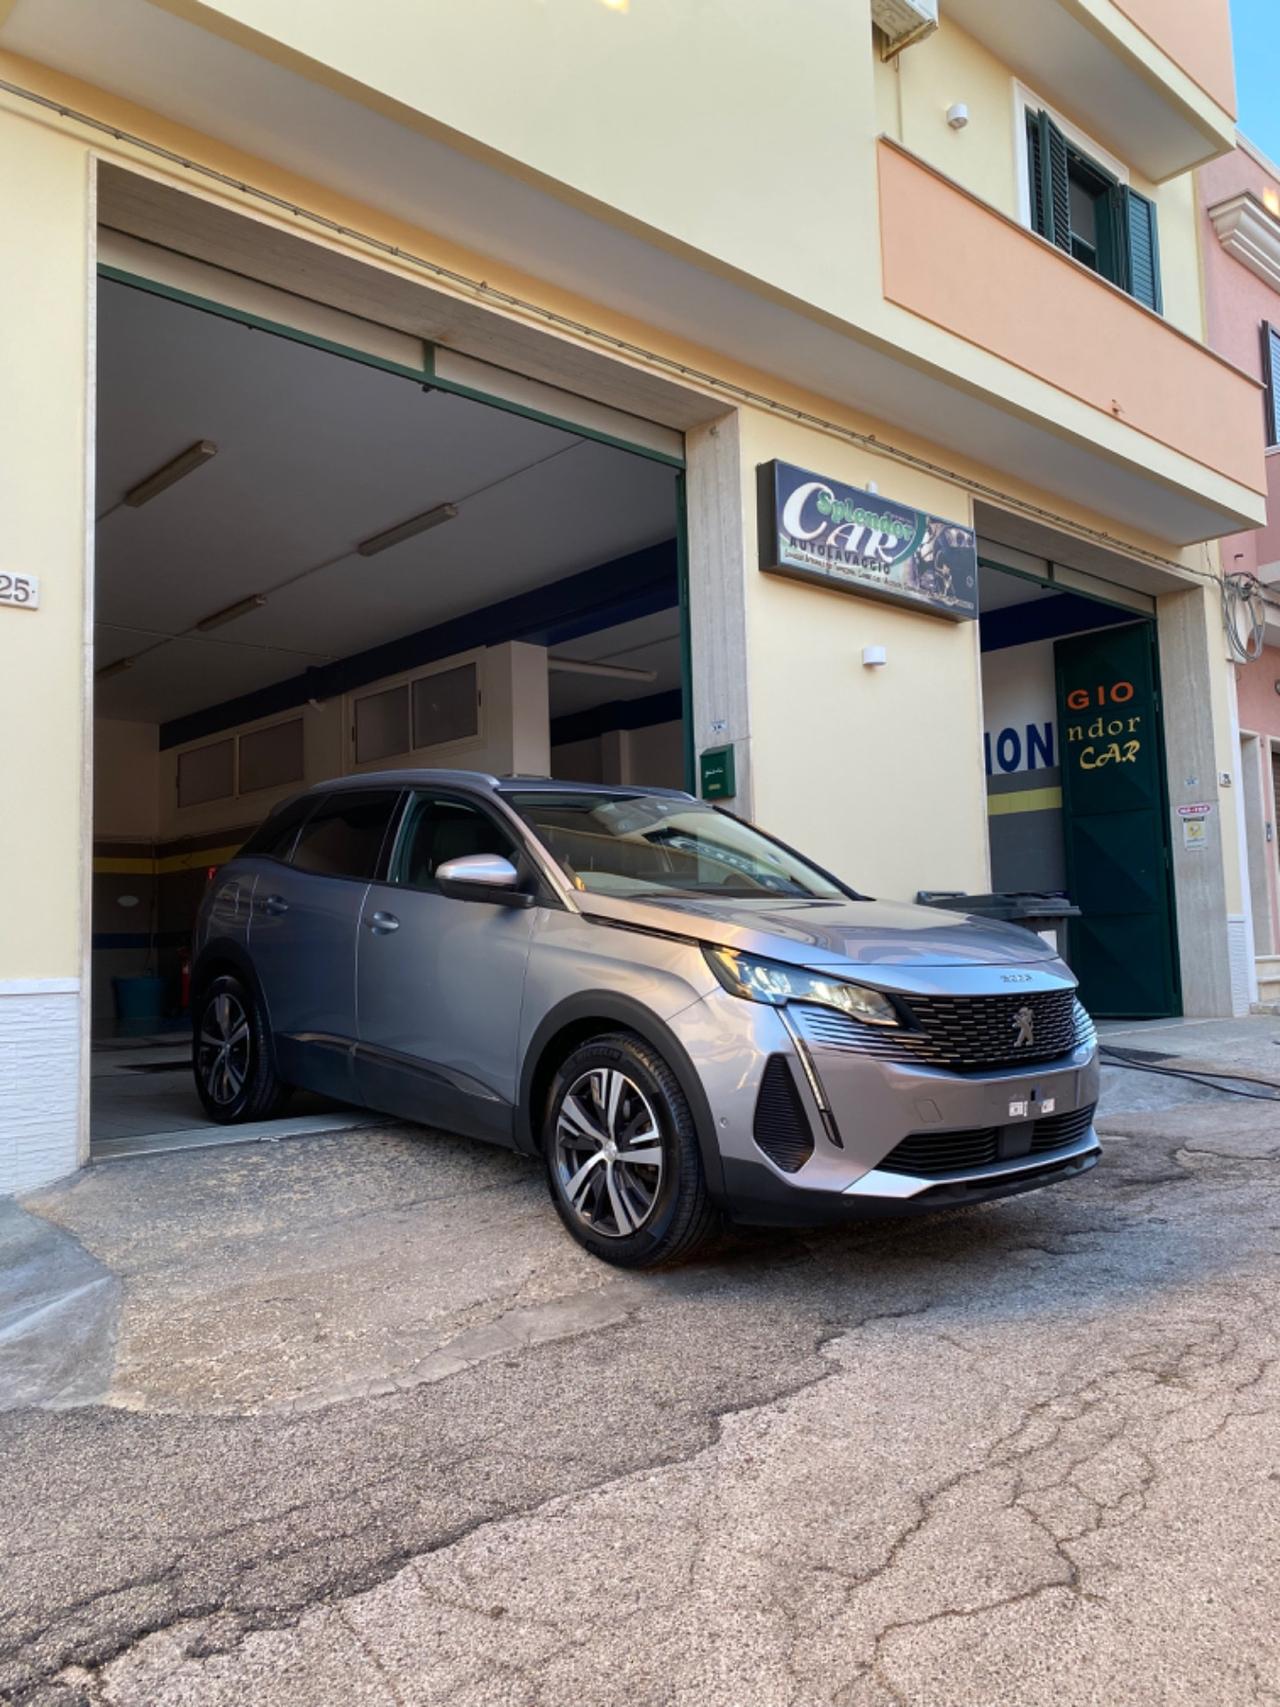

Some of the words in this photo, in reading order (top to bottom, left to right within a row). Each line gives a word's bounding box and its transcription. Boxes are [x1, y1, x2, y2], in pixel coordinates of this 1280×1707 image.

[783, 482, 898, 563] CAR
[816, 491, 913, 541] Splendor
[790, 537, 891, 575] AUTOLAVAGGIO
[1067, 681, 1134, 710] GIO
[1068, 716, 1141, 742] ndor
[1079, 739, 1141, 770] CAR
